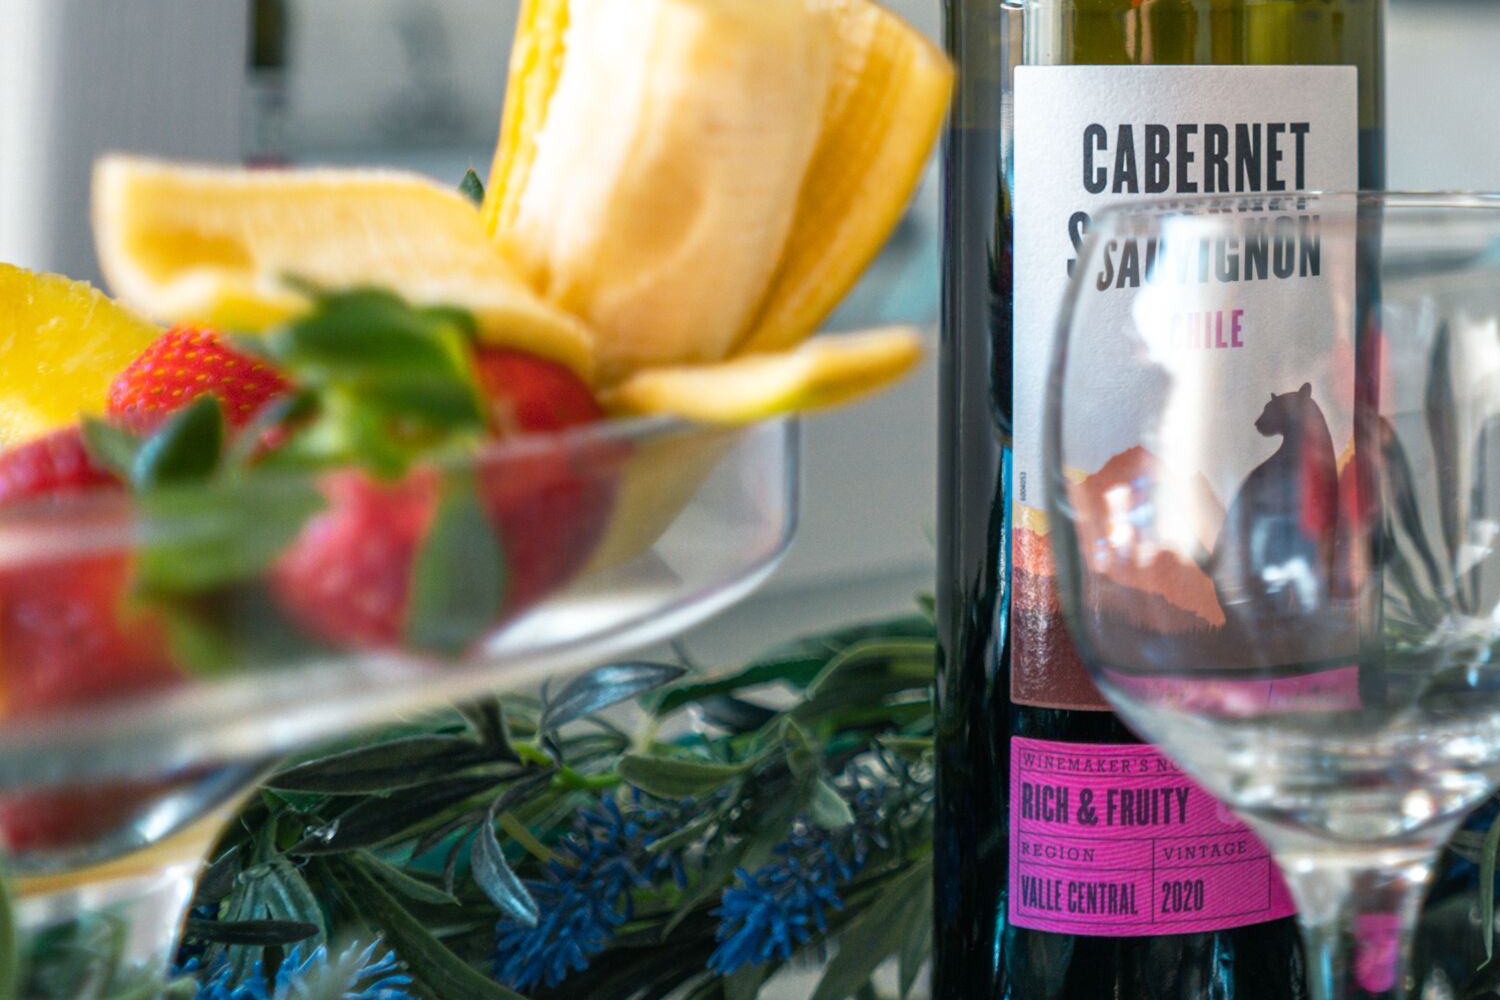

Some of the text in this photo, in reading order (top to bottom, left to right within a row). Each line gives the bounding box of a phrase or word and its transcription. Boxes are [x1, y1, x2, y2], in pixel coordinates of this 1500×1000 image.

[1083, 122, 1310, 194] CABERNET
[1171, 309, 1244, 349] HILE
[1023, 754, 1149, 773] WINEMAKER'S
[1022, 783, 1190, 826] RICH & FRUITY
[1022, 842, 1095, 862] REGION
[1164, 840, 1248, 860] VINTAGE
[1021, 875, 1139, 915] VALLE CENTRAL
[1161, 879, 1205, 913] 2020
